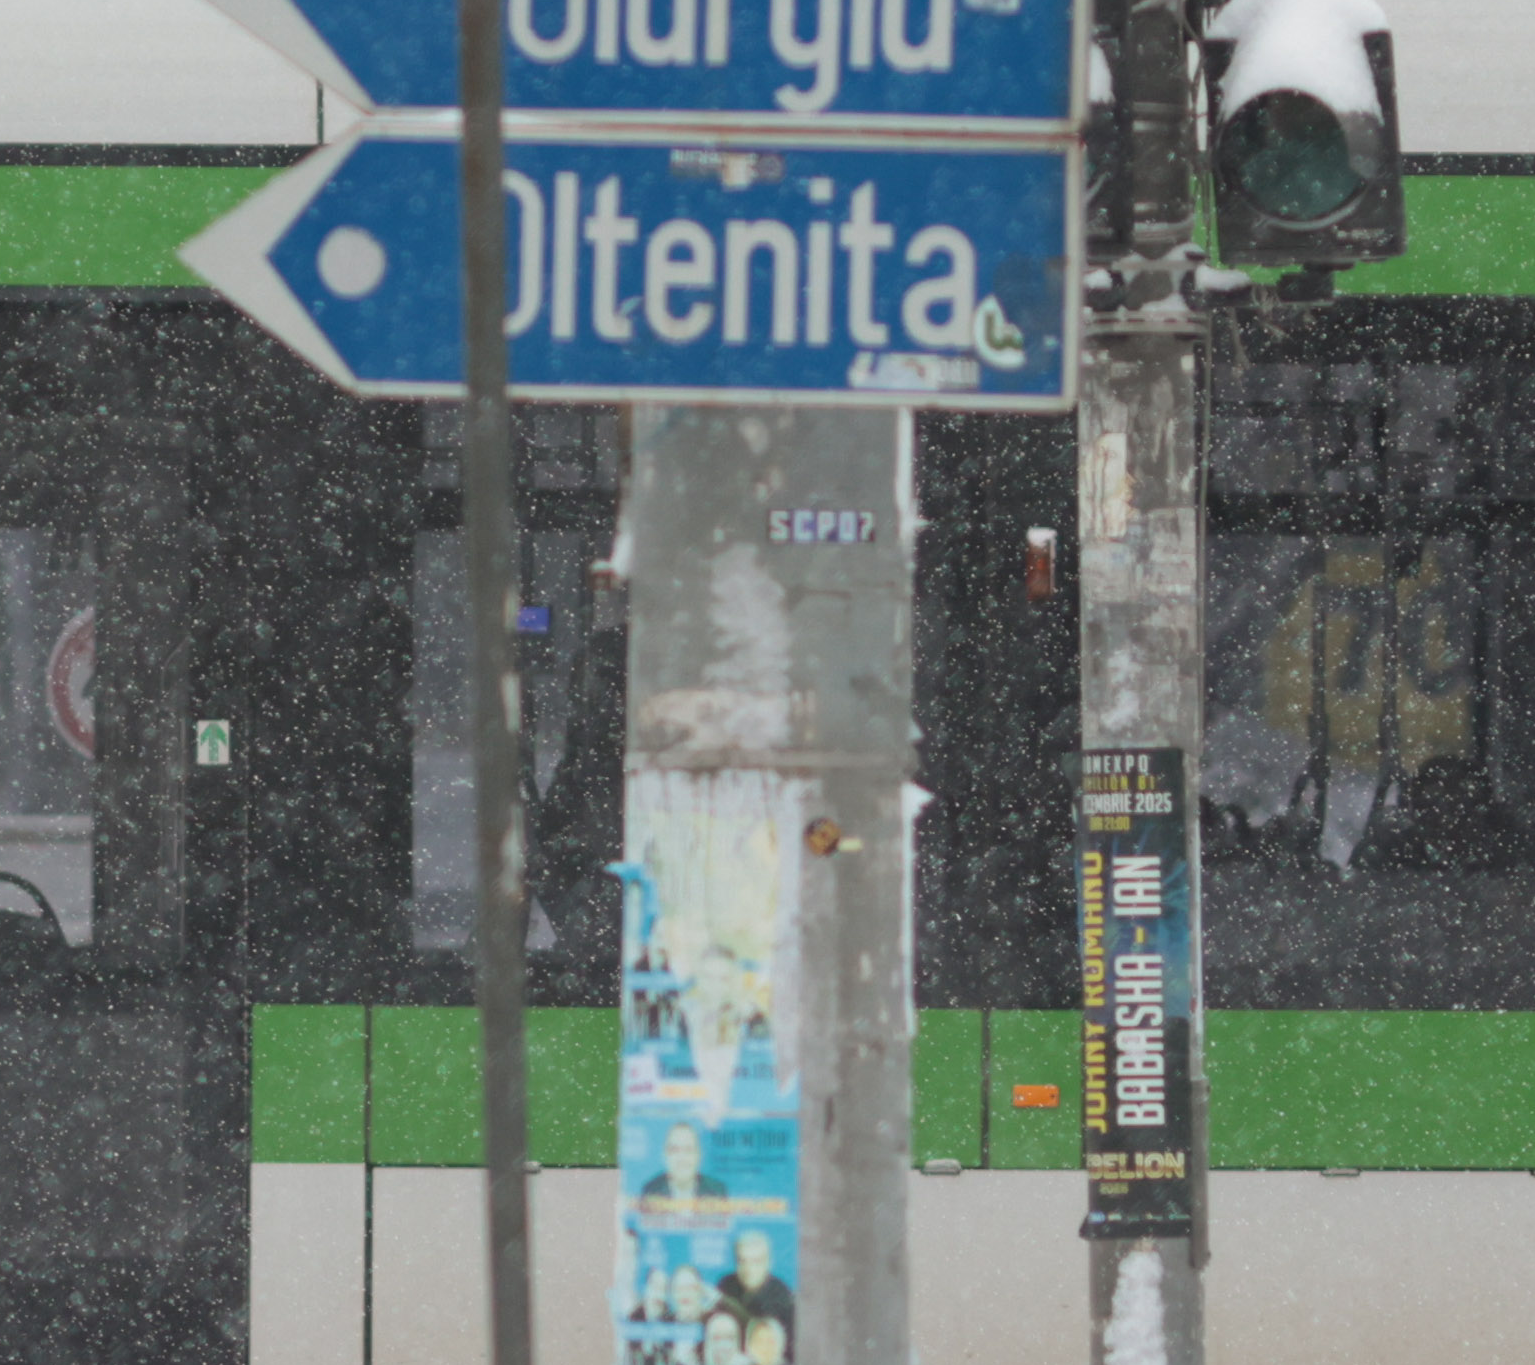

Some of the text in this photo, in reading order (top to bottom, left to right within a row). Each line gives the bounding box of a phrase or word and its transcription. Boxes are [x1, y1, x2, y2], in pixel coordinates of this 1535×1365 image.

[1135, 792, 1172, 813] 2025
[1112, 855, 1162, 916] IAN
[1113, 954, 1165, 1126] BABASHA
